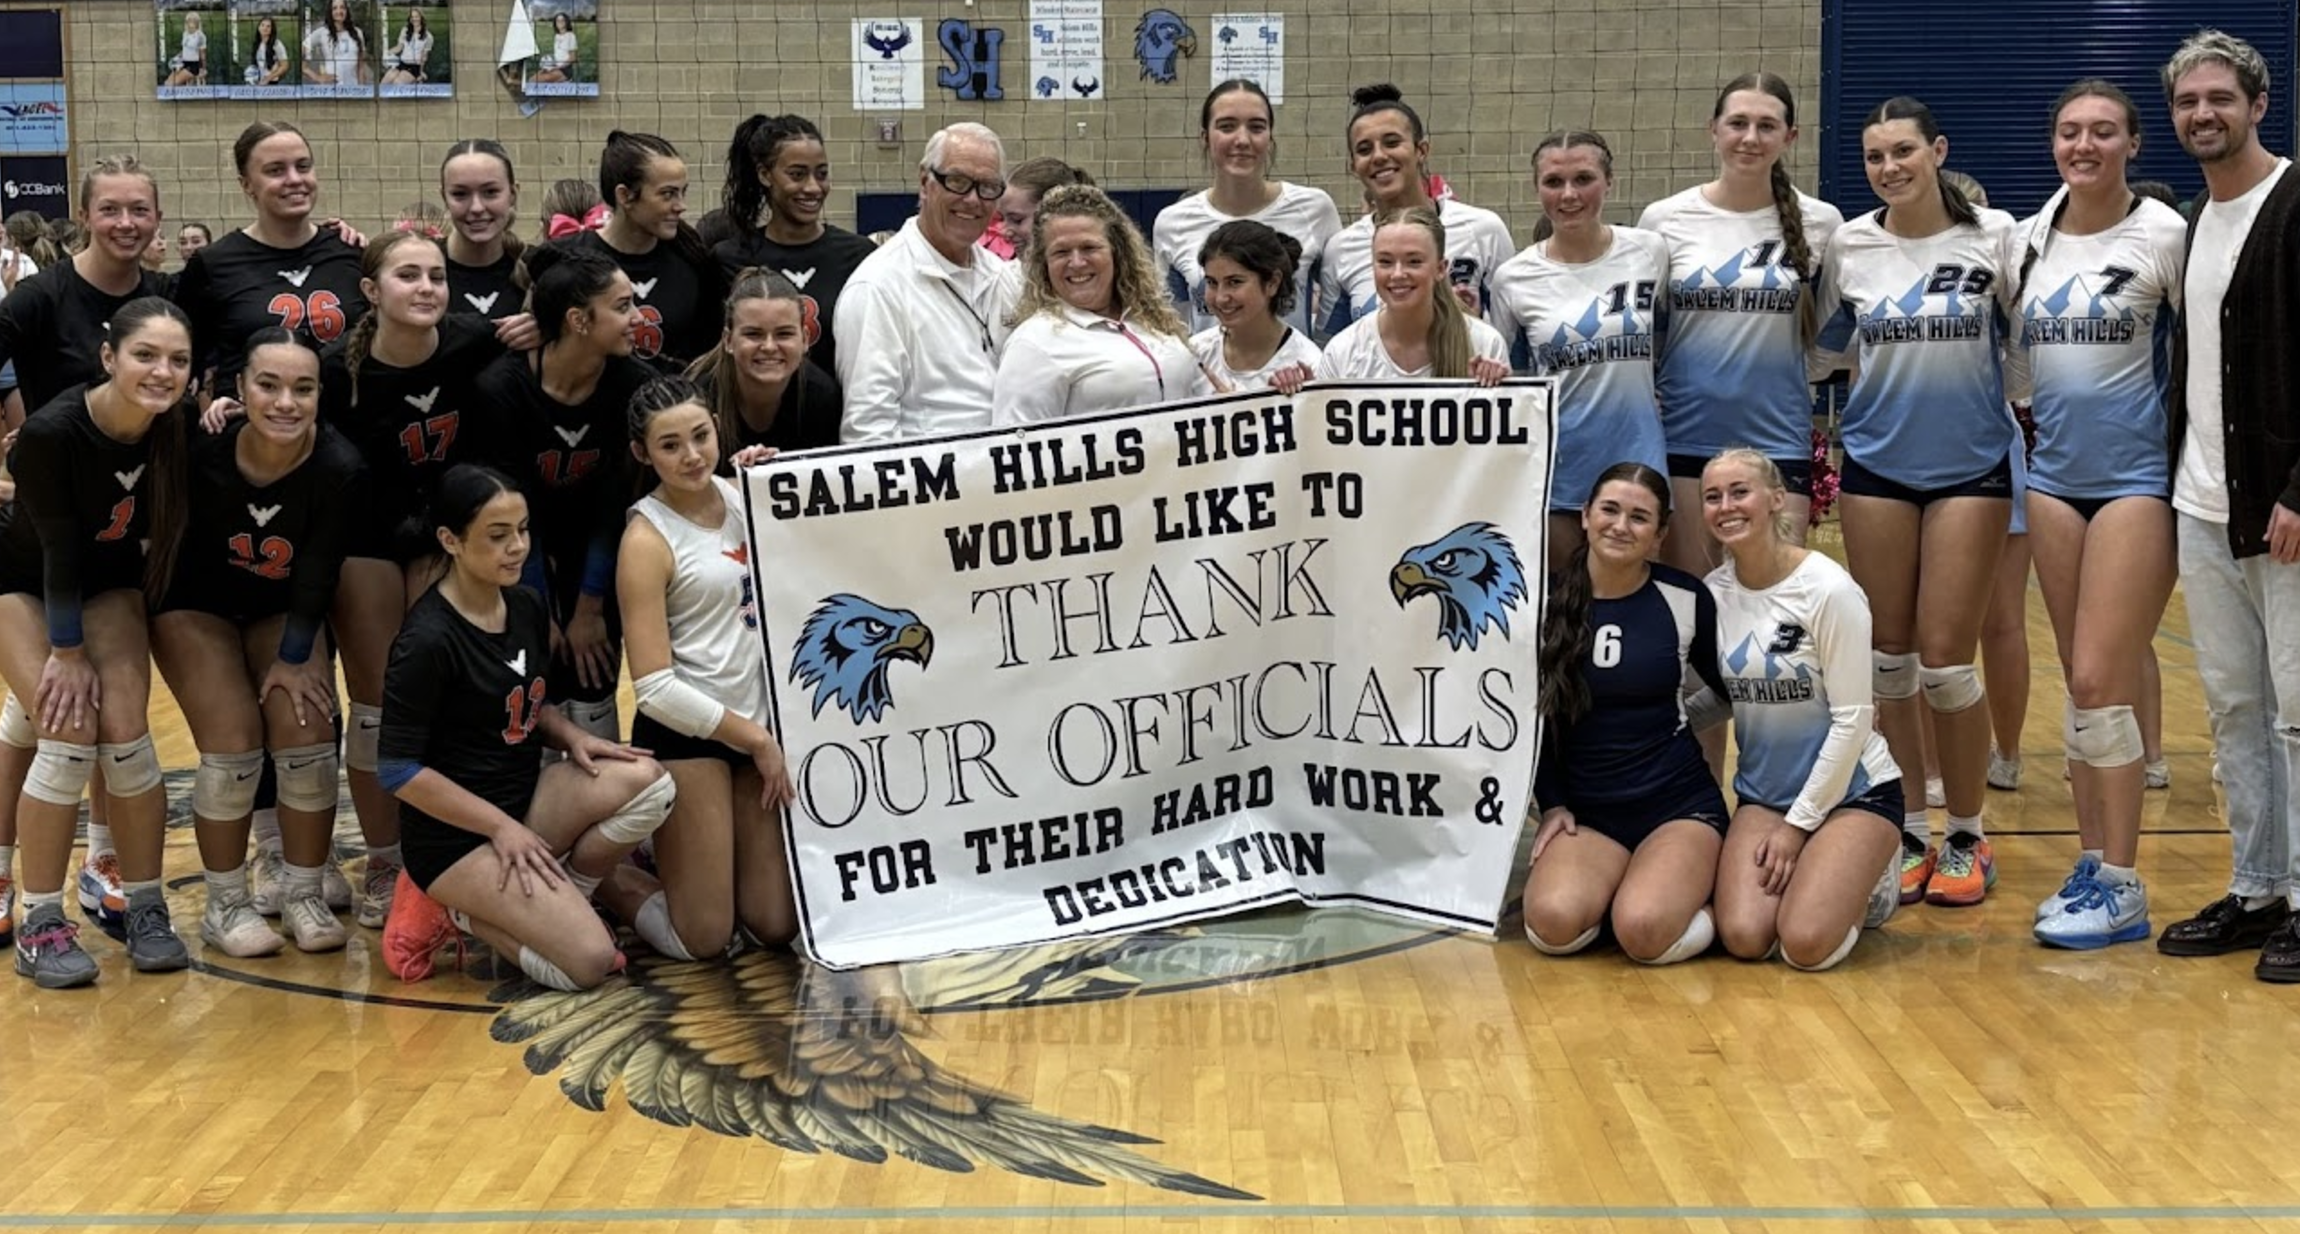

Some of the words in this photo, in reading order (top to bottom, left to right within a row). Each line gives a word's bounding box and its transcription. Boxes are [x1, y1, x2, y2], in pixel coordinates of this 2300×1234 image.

[1033, 25, 1054, 43] SH
[938, 18, 1004, 100] SH
[1604, 279, 1658, 316] 15
[1671, 279, 1739, 312] SALEM
[1926, 263, 1995, 295] 29
[2098, 265, 2139, 296] 7
[268, 290, 346, 342] 26
[1858, 314, 1925, 346] SALEM
[1926, 314, 1983, 342] HILLS
[2069, 318, 2136, 344] HILLS
[1604, 334, 1654, 362] HILLS
[400, 410, 459, 466] 17
[769, 453, 960, 520] SALEM
[989, 428, 1145, 494] HILLS
[1174, 404, 1296, 467] HIGH
[1326, 398, 1529, 446] SCHOOL
[95, 497, 135, 541] 1
[945, 504, 1123, 572] WOULD
[1152, 481, 1276, 543] LIKE
[1302, 472, 1363, 519] TO
[228, 533, 294, 579] 12
[971, 538, 1336, 669] THANK
[1592, 624, 1622, 669] 6
[1769, 620, 1808, 653] 3
[1752, 678, 1815, 704] HILLS
[797, 719, 1020, 829] OUR
[1048, 661, 1519, 787] OFFICIALS
[835, 838, 937, 902] FOR
[964, 806, 1125, 875] THEIR
[1151, 765, 1274, 835] HARD
[1303, 762, 1444, 817] WORK
[1475, 776, 1504, 826] &
[1043, 831, 1325, 927] DEDICATION
